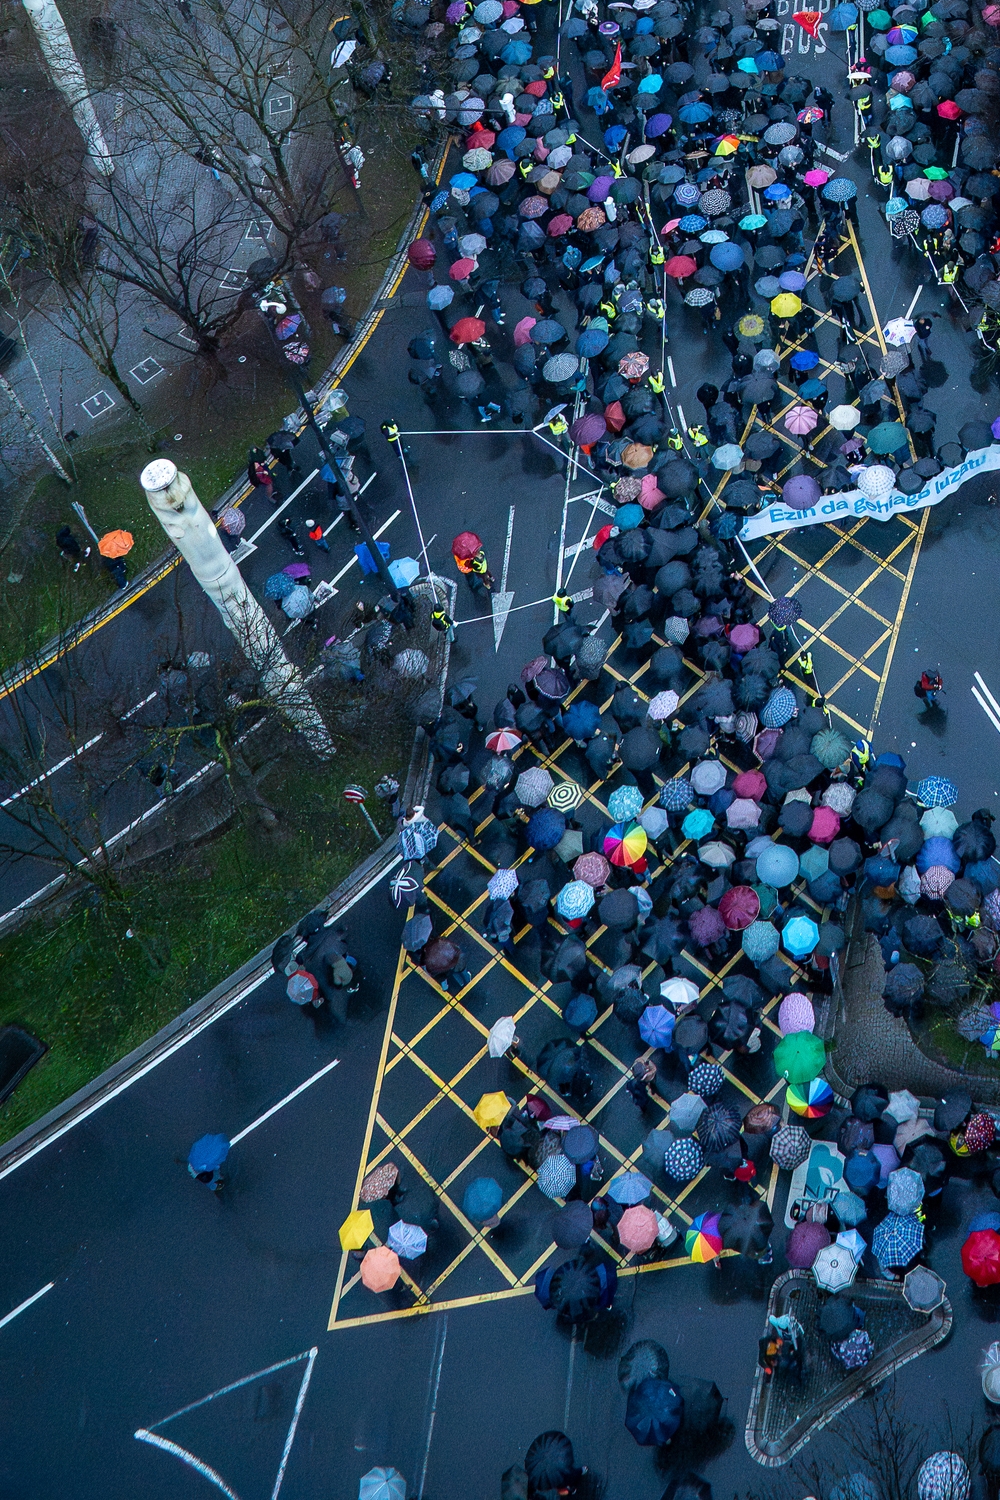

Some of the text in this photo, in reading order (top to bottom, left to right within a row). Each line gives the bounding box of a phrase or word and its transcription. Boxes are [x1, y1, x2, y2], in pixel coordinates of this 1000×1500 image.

[781, 22, 828, 55] BUS
[769, 454, 987, 523] Ezin da gehiago luzatu
